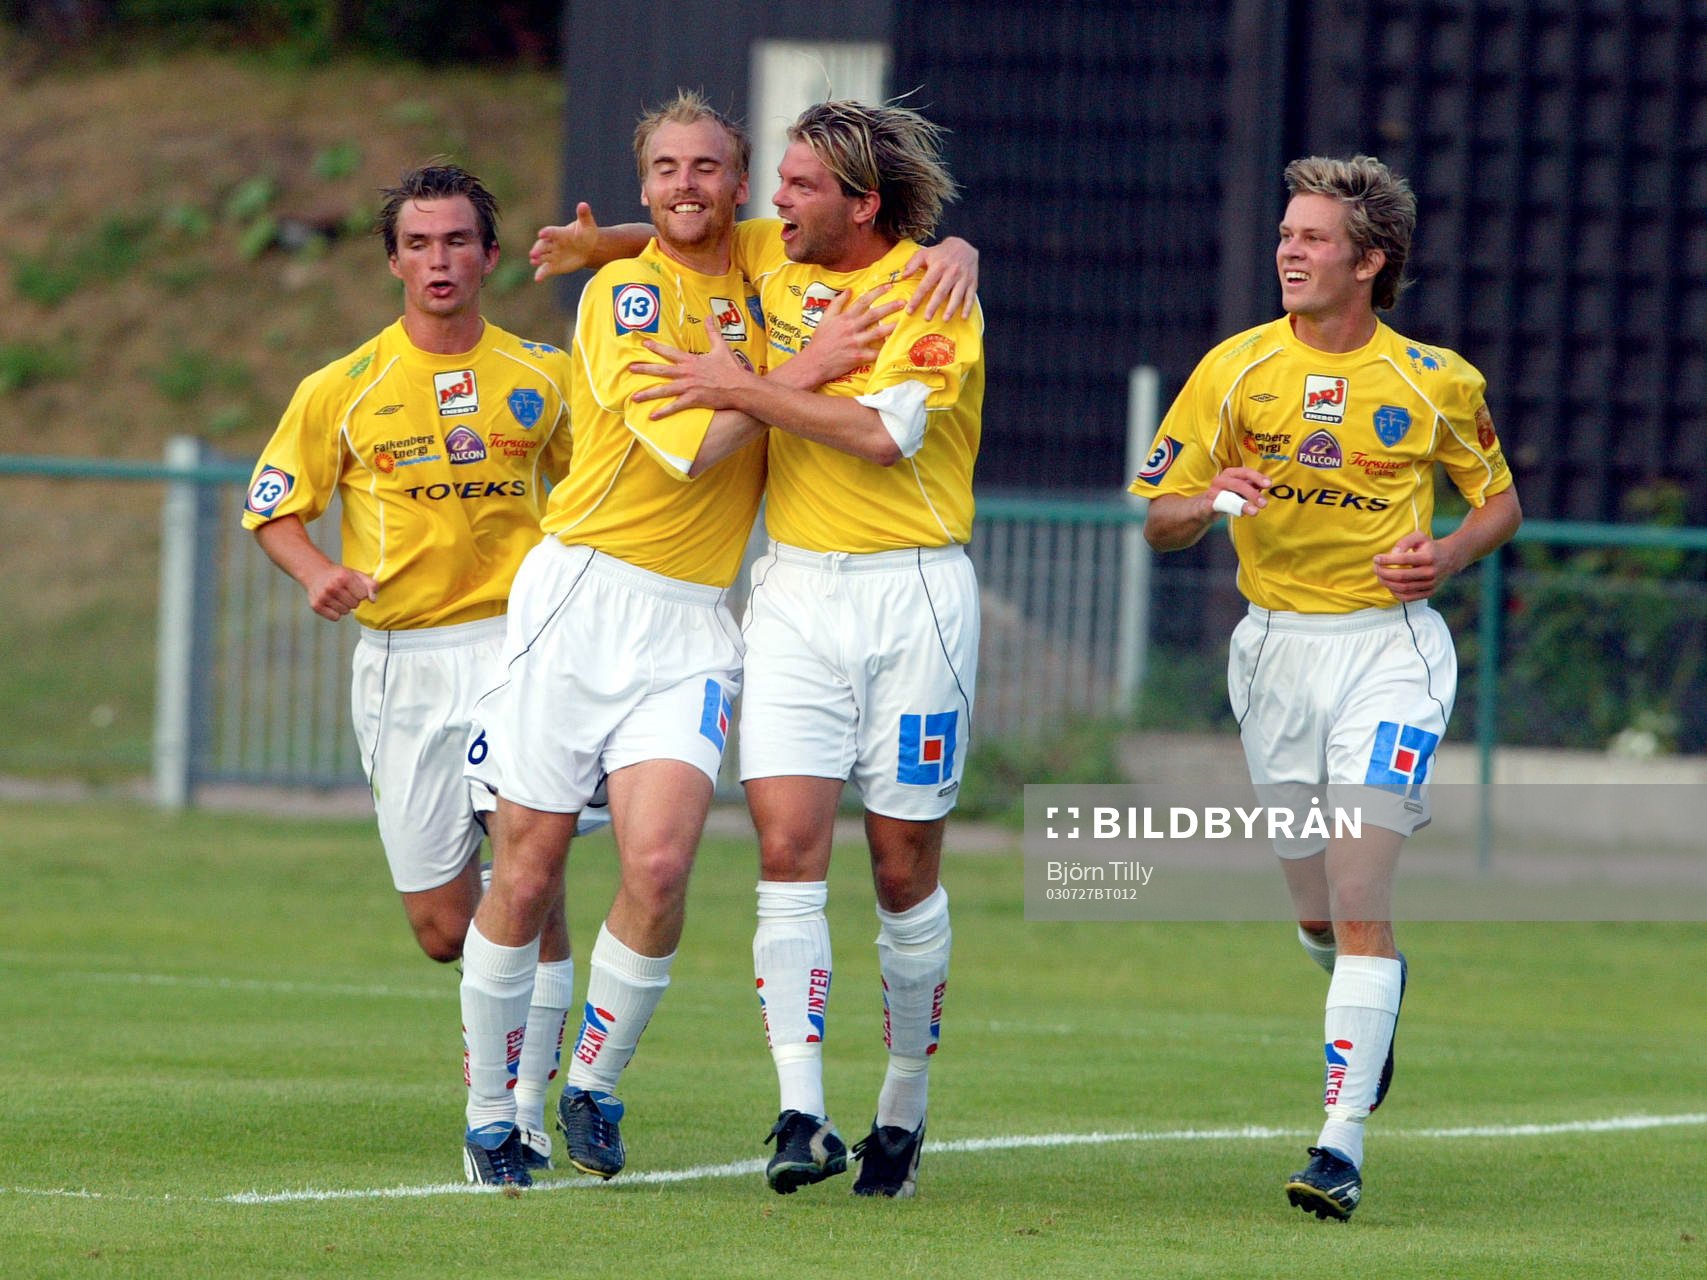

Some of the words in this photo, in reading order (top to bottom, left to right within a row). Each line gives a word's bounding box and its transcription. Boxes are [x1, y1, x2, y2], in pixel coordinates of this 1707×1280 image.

[621, 297, 650, 318] 13
[373, 435, 435, 455] Falkenberg
[393, 446, 429, 460] Energi
[449, 450, 485, 461] ALCON
[1146, 448, 1166, 467] 3
[1299, 453, 1340, 467] FALCON
[254, 481, 282, 502] 13
[1268, 484, 1391, 512] OVEKS
[467, 728, 488, 765] 6
[808, 968, 829, 1015] INTER
[575, 1025, 608, 1065] INTER
[1324, 1065, 1347, 1106] INTER
